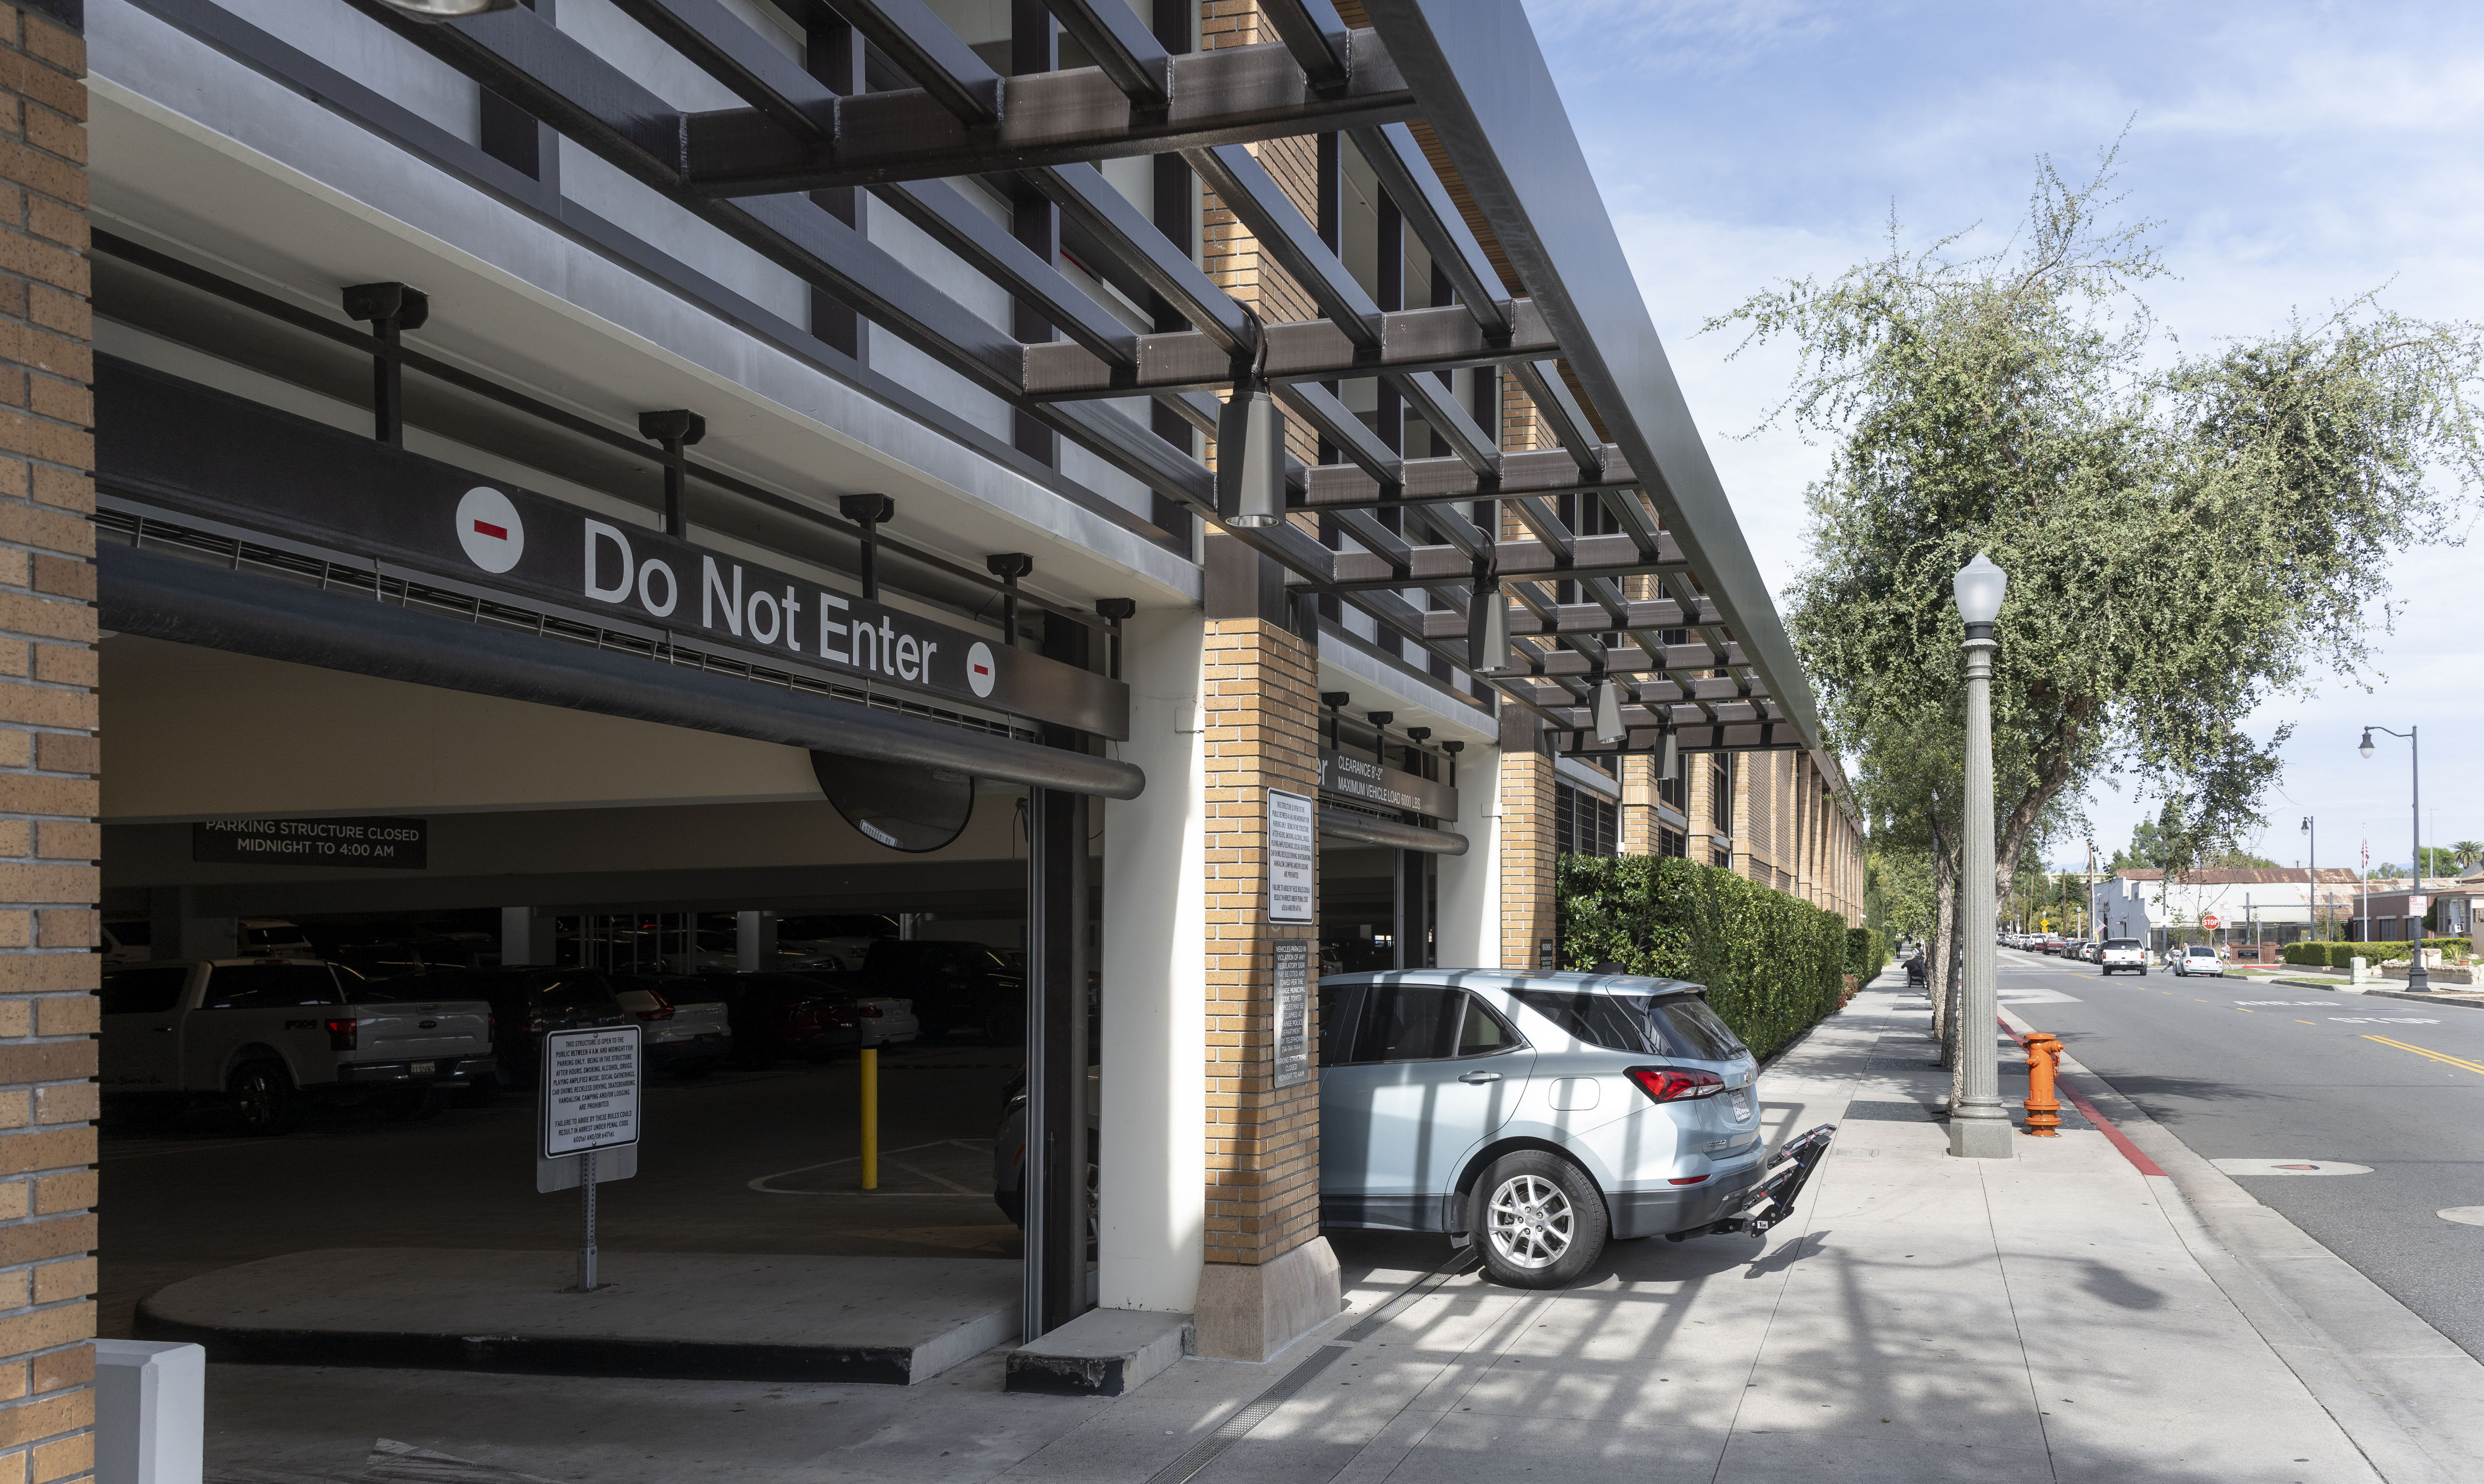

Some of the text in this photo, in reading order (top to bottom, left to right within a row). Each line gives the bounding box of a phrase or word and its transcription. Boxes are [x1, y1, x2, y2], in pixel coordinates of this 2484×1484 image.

[585, 517, 937, 685] Do Not Enter
[1338, 756, 1371, 777] CLEARANCE
[1338, 776, 1420, 810] MAXIMUM VEHICLE LOAD 6000 LBS
[206, 820, 419, 841] PARKING STRUCTURE CLOSED
[237, 838, 394, 857] MIDNIGHT TO 4:00 AM
[1282, 1028, 1301, 1036] DEPARTMENT
[575, 1039, 597, 1047] STRUCTURE
[571, 1049, 587, 1057] BETWEEN
[1276, 1054, 1307, 1065] PARKING STRUCTURE
[1285, 1064, 1297, 1072] CLOSED
[569, 1076, 588, 1084] AMPLIFIED
[1278, 1072, 1292, 1082] MIDNIGHT
[574, 1085, 592, 1093] RECKLESS
[555, 1119, 571, 1127] FAILURE
[558, 1128, 573, 1136] RESULT
[579, 1125, 593, 1133] ARREST
[587, 1133, 601, 1141] AND/OR
